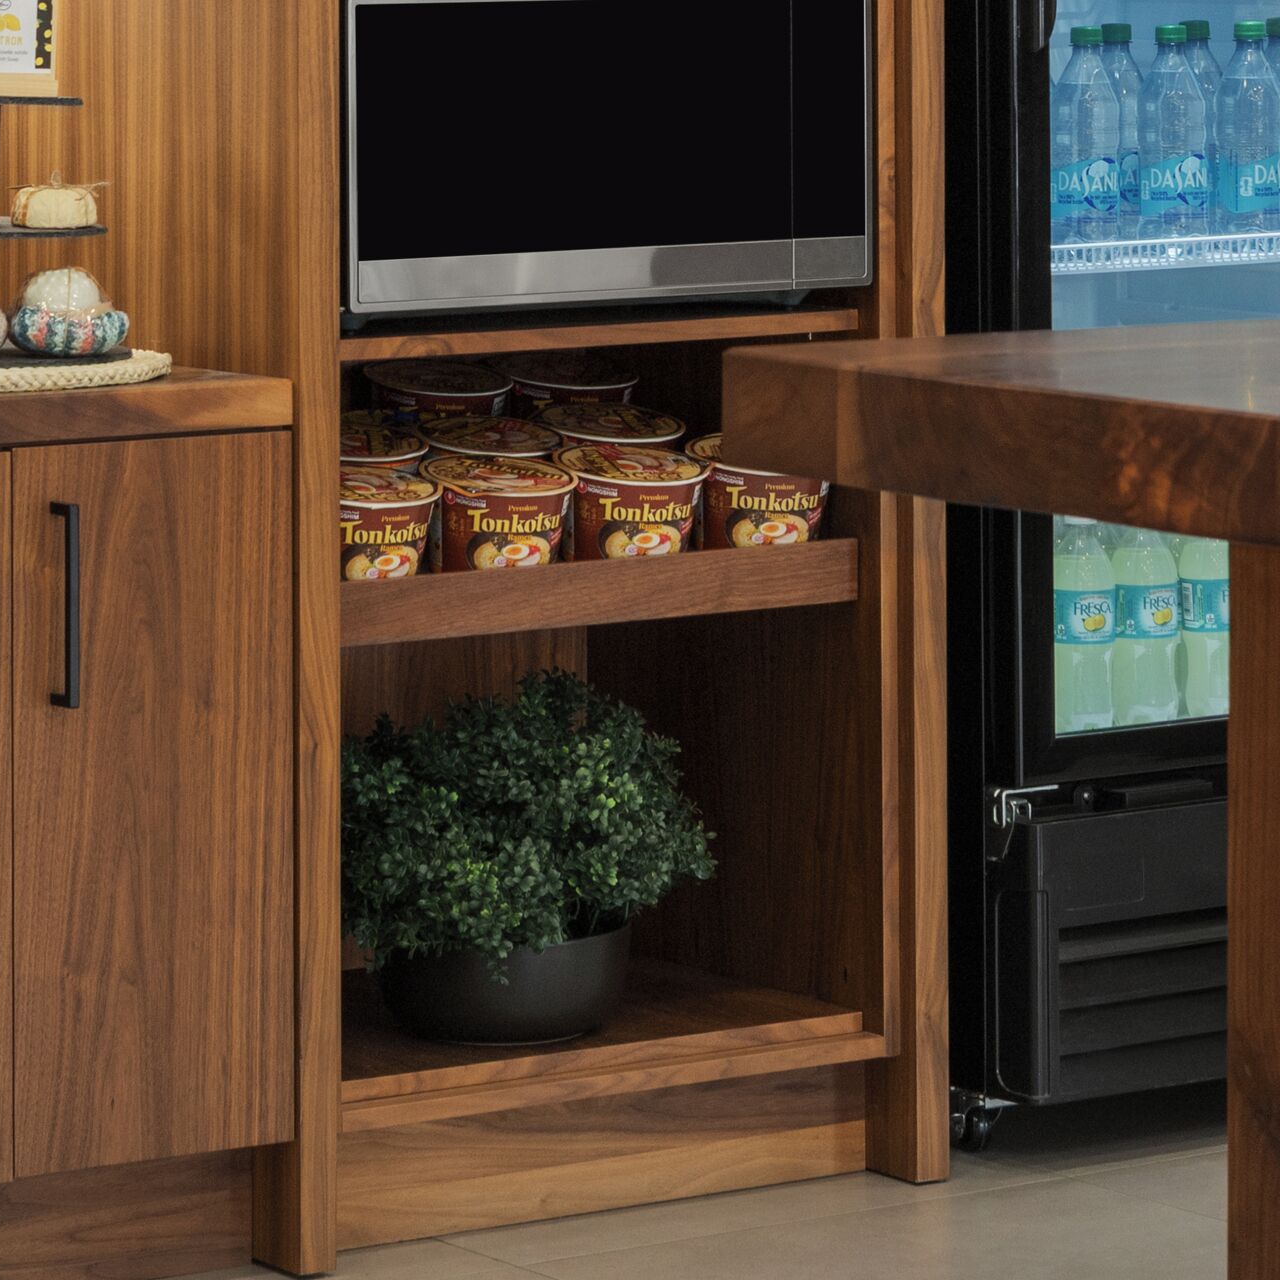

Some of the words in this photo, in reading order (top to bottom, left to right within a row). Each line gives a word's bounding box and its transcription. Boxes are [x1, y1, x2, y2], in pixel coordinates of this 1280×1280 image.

[1058, 165, 1119, 198] DASANI
[598, 497, 692, 522] Tonkotsu
[726, 485, 820, 511] Tonkotsu
[339, 520, 429, 545] Tonkotsu
[467, 508, 561, 533] Tonkotsu
[1072, 601, 1112, 618] FRESCA
